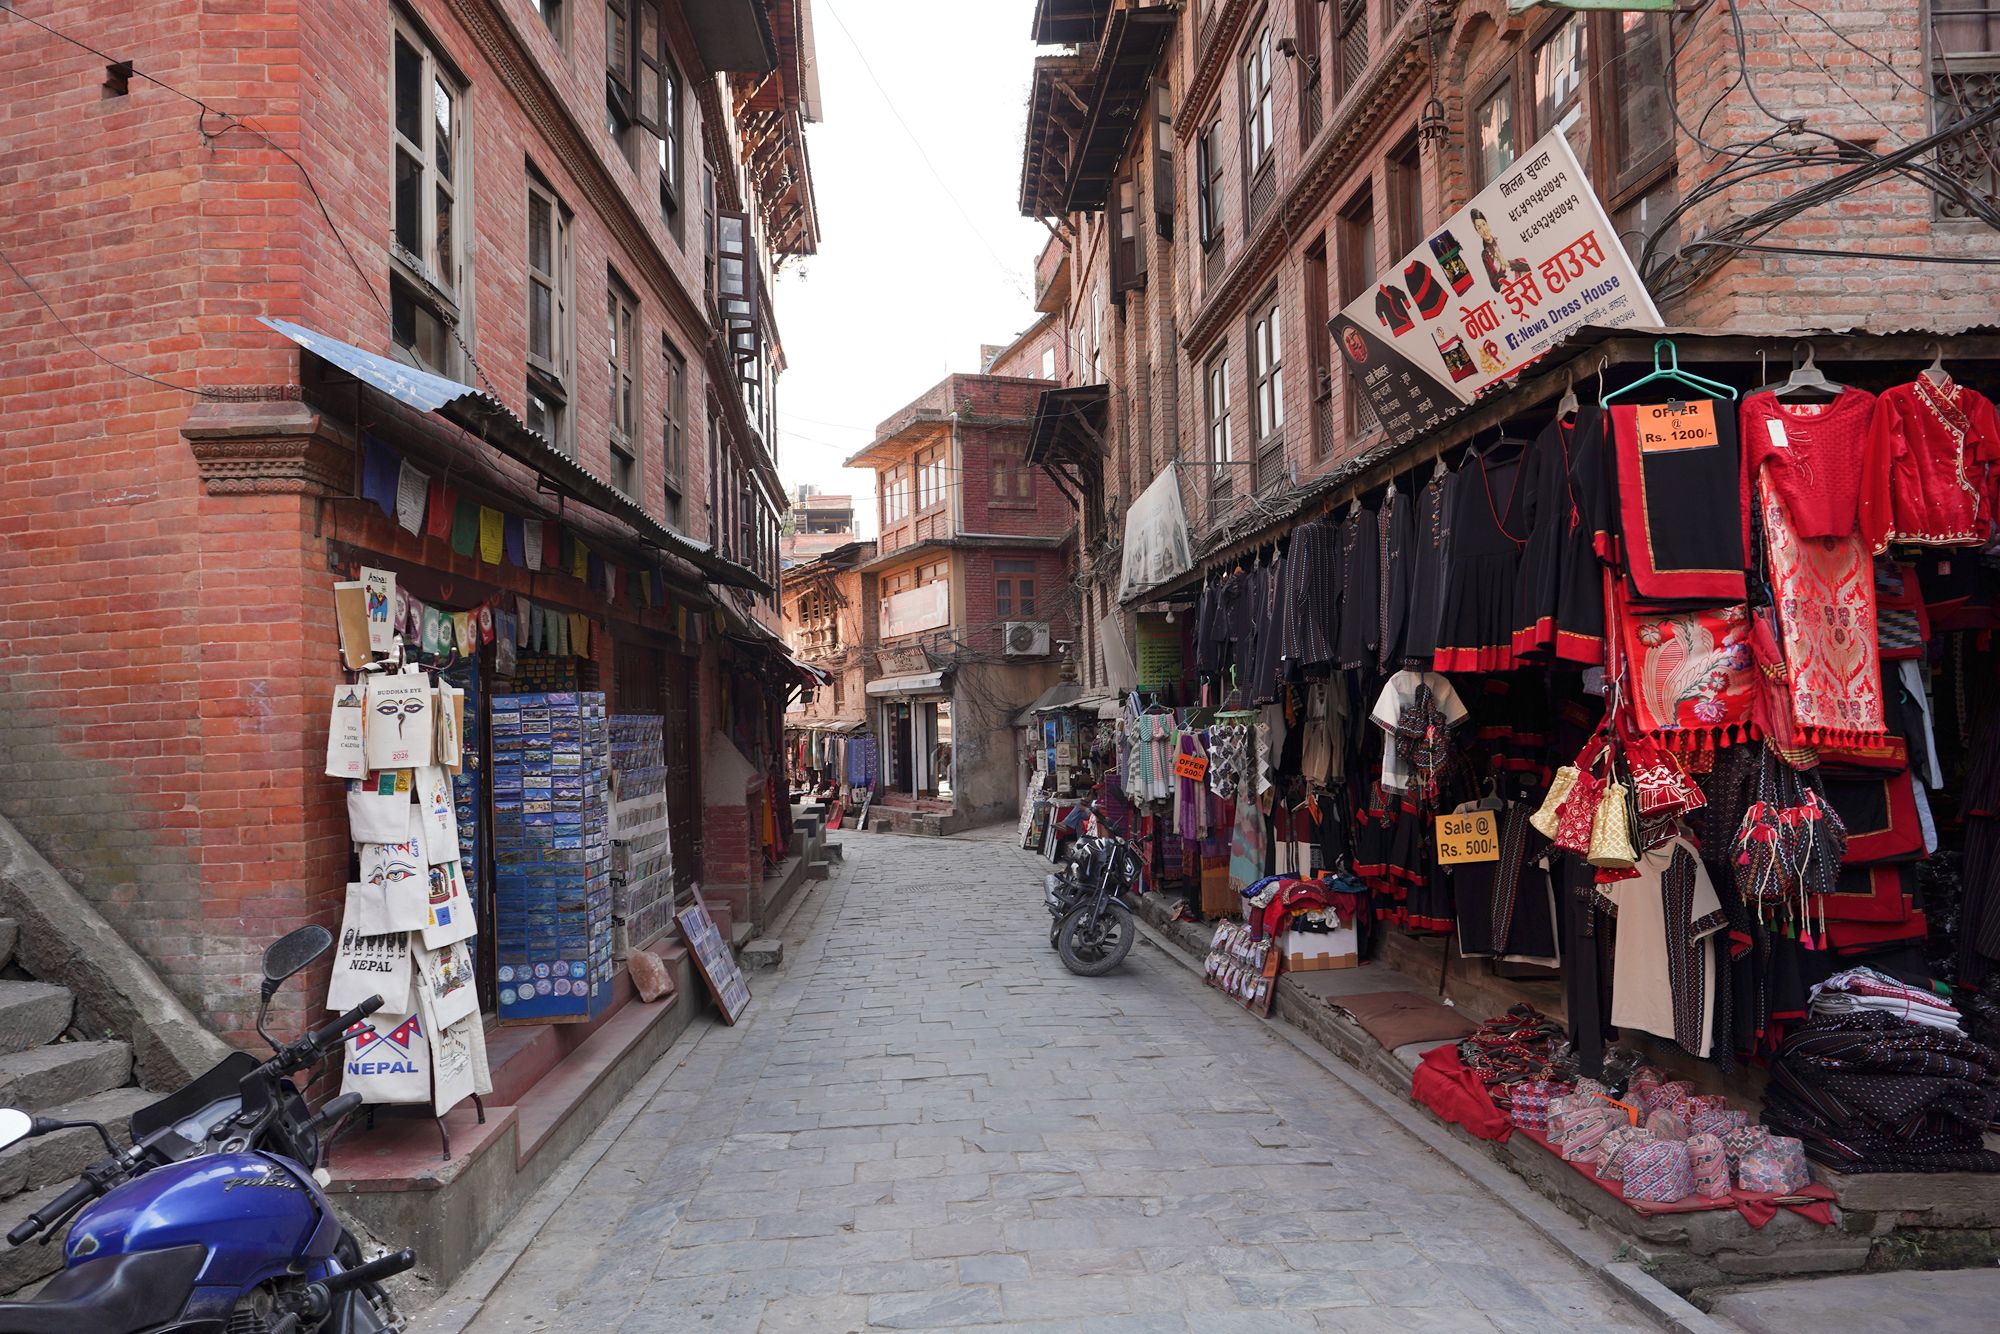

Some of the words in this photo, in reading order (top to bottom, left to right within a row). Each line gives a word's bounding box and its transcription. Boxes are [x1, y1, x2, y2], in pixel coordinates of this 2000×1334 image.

[1500, 172, 1525, 198] मिलन
[1525, 152, 1551, 179] सुवाल
[1498, 271, 1543, 322] ड्रेस
[1537, 229, 1606, 294] हाउस
[1548, 299, 1581, 324] Dress
[1580, 275, 1620, 304] House
[1652, 405, 1698, 418] OFER
[1645, 433, 1666, 443] Rs.
[1671, 428, 1713, 441] 1200/-
[1180, 759, 1205, 771] OFFER
[1444, 820, 1472, 836] Sale
[1476, 817, 1490, 835] @
[1440, 843, 1462, 857] Rs.
[1466, 838, 1497, 855] 500/-
[349, 959, 393, 973] NEPAL
[347, 1061, 419, 1076] NEPAL
